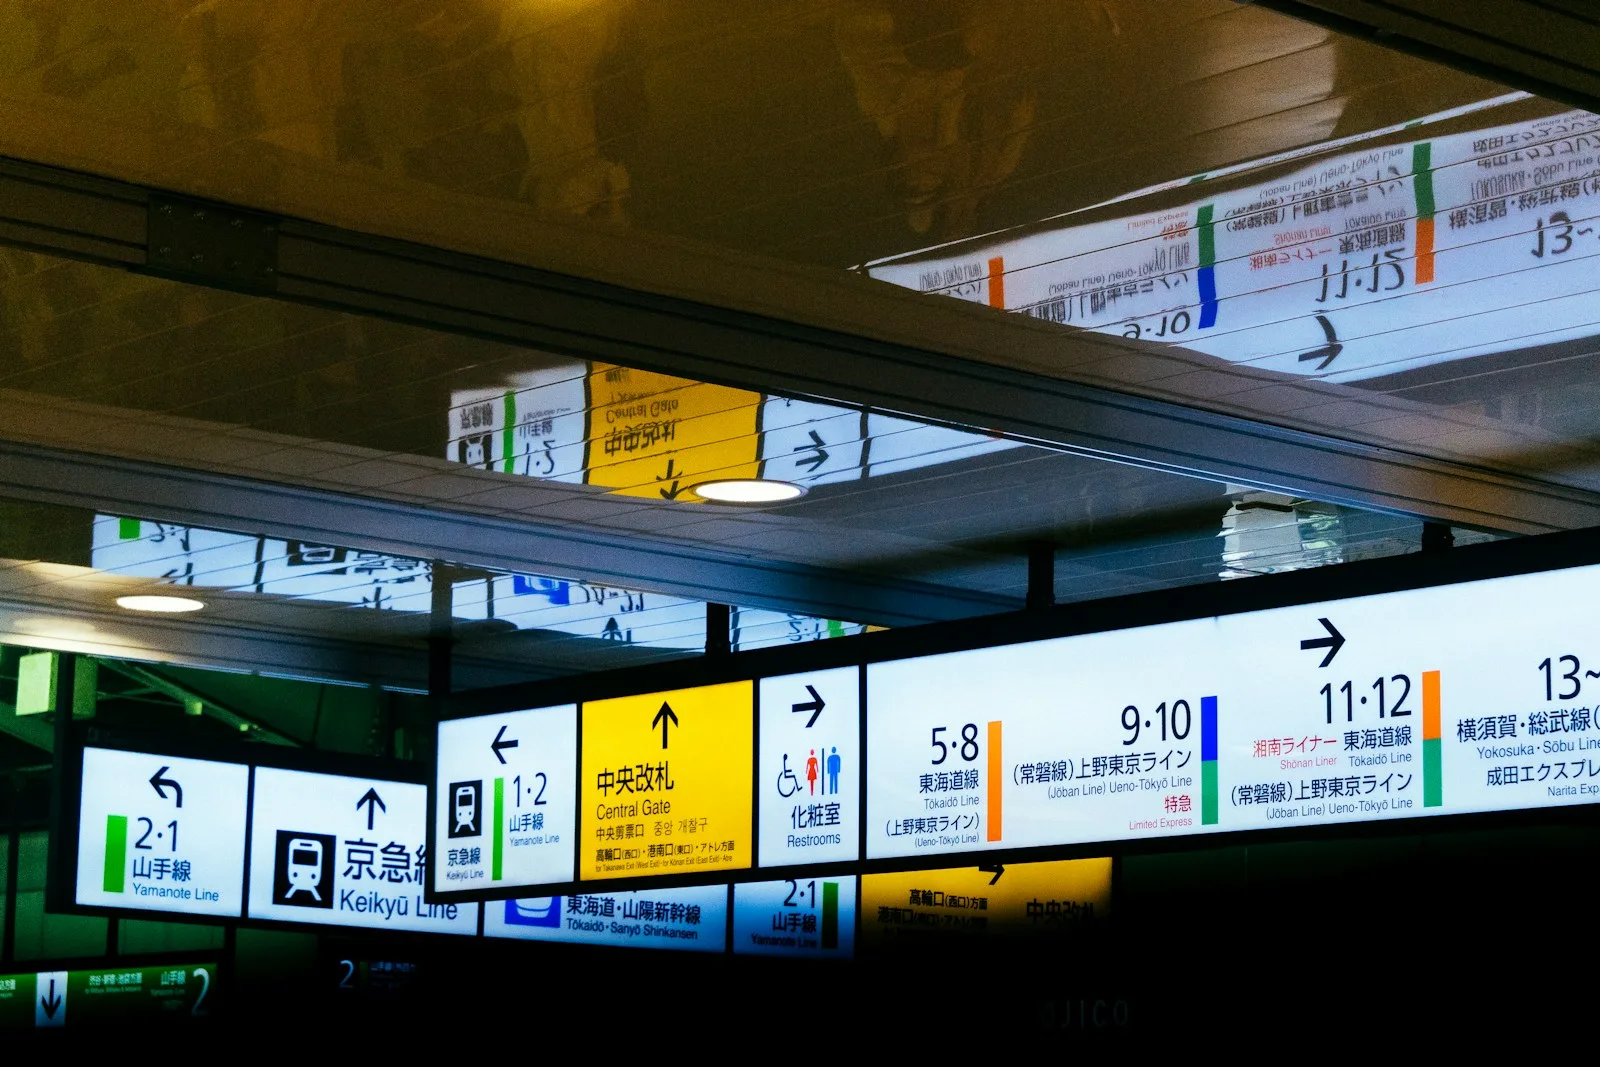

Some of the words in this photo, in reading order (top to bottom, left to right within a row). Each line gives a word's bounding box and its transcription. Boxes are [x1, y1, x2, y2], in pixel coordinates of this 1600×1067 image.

[1252, 734, 1338, 758] 湘南ライナー
[1343, 724, 1412, 752] 東海道線
[1579, 738, 1600, 751] Line
[1315, 756, 1337, 767] Liner
[1348, 753, 1389, 768] Tōkaidō
[1390, 751, 1412, 764] Line
[596, 760, 675, 798] 中央改札
[919, 769, 979, 794] 東海道線
[1047, 786, 1080, 801] (Jōban
[1082, 784, 1106, 798] Line)
[1109, 777, 1168, 795] Ueno-Tōkyō
[1171, 775, 1193, 788] Line
[513, 772, 547, 808] 1・2
[1547, 784, 1577, 797] Narita
[596, 801, 639, 821] Central
[642, 799, 671, 816] Gate
[924, 796, 958, 809] Tōkaidō
[960, 795, 979, 806] Line
[1164, 794, 1192, 814] 特急
[1265, 807, 1299, 821] (Jōban
[1301, 804, 1326, 818] Line)
[1328, 799, 1389, 815] Ueno-Tōkyō
[1391, 797, 1413, 810] Line
[509, 813, 544, 833] 山手線
[791, 802, 841, 830] 化粧室
[886, 812, 980, 838] (上野東京ライン)
[1129, 819, 1158, 831] Limited
[1160, 817, 1193, 830] Express
[509, 836, 543, 848] Yamanote
[544, 834, 560, 845] Line
[787, 833, 841, 848] Restrooms
[961, 834, 980, 845] Line)
[447, 847, 481, 867] 京急線
[133, 857, 191, 883] 山手線
[470, 869, 485, 880] Line
[133, 883, 192, 902] Yamanote
[195, 887, 219, 902] Line
[340, 889, 408, 921] Keikyū
[567, 896, 701, 924] 東海道・山陽新幹線
[643, 925, 699, 940] Shinkansen
[772, 912, 816, 933] 山手線
[751, 932, 796, 946] Yamanote
[339, 959, 355, 989] 2
[191, 967, 211, 1017] 2
